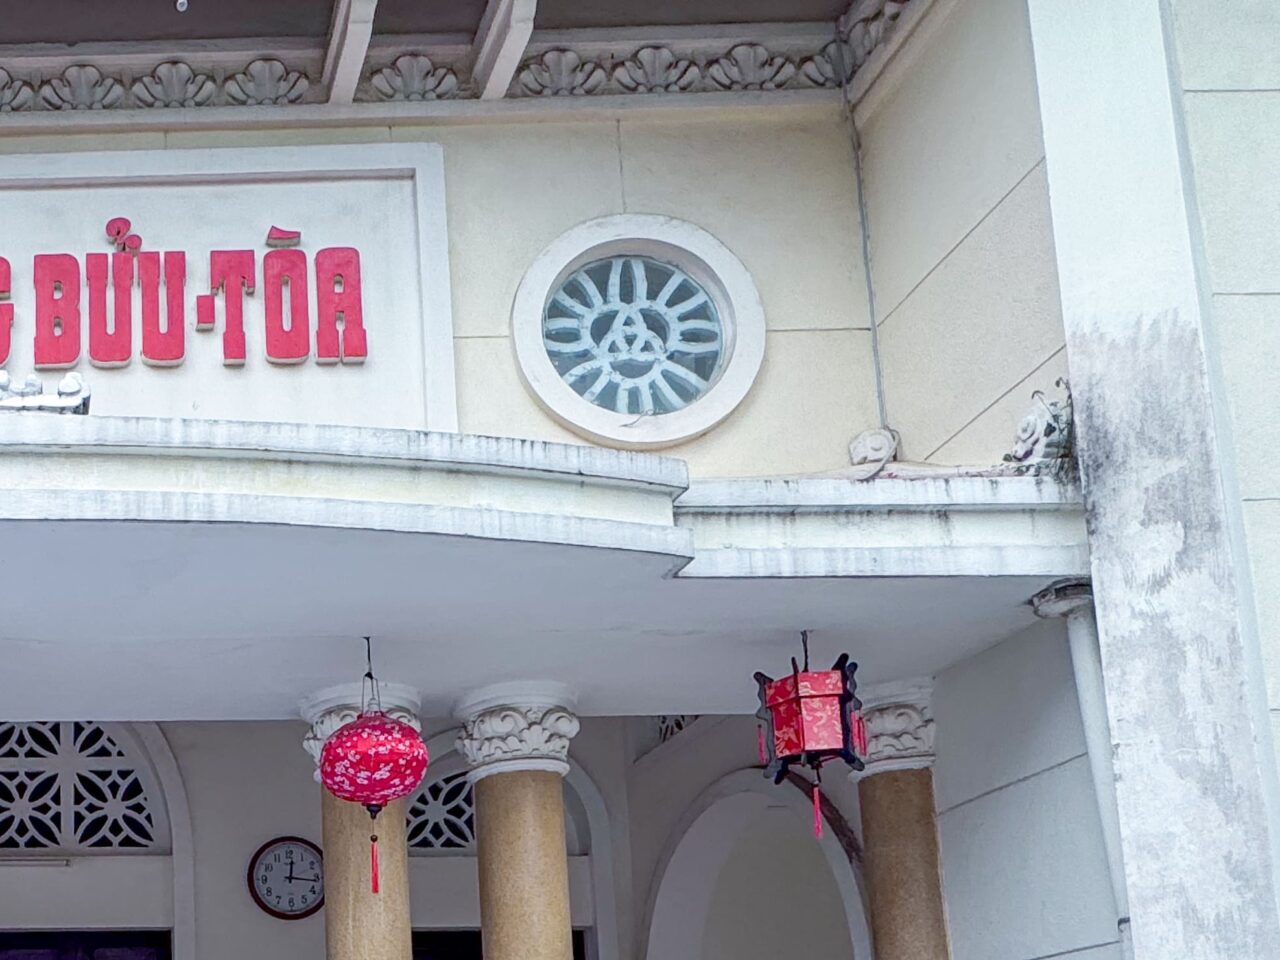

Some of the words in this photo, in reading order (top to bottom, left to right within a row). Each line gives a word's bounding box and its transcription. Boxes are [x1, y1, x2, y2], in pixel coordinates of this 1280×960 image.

[33, 217, 367, 367] BỬU-TÒA
[274, 853, 280, 863] 11
[264, 863, 273, 872] 10
[261, 874, 268, 885] 9
[266, 886, 272, 897] 8
[309, 885, 316, 895] 4
[275, 895, 281, 905] 7
[288, 897, 295, 908] 6
[301, 894, 308, 904] 5
